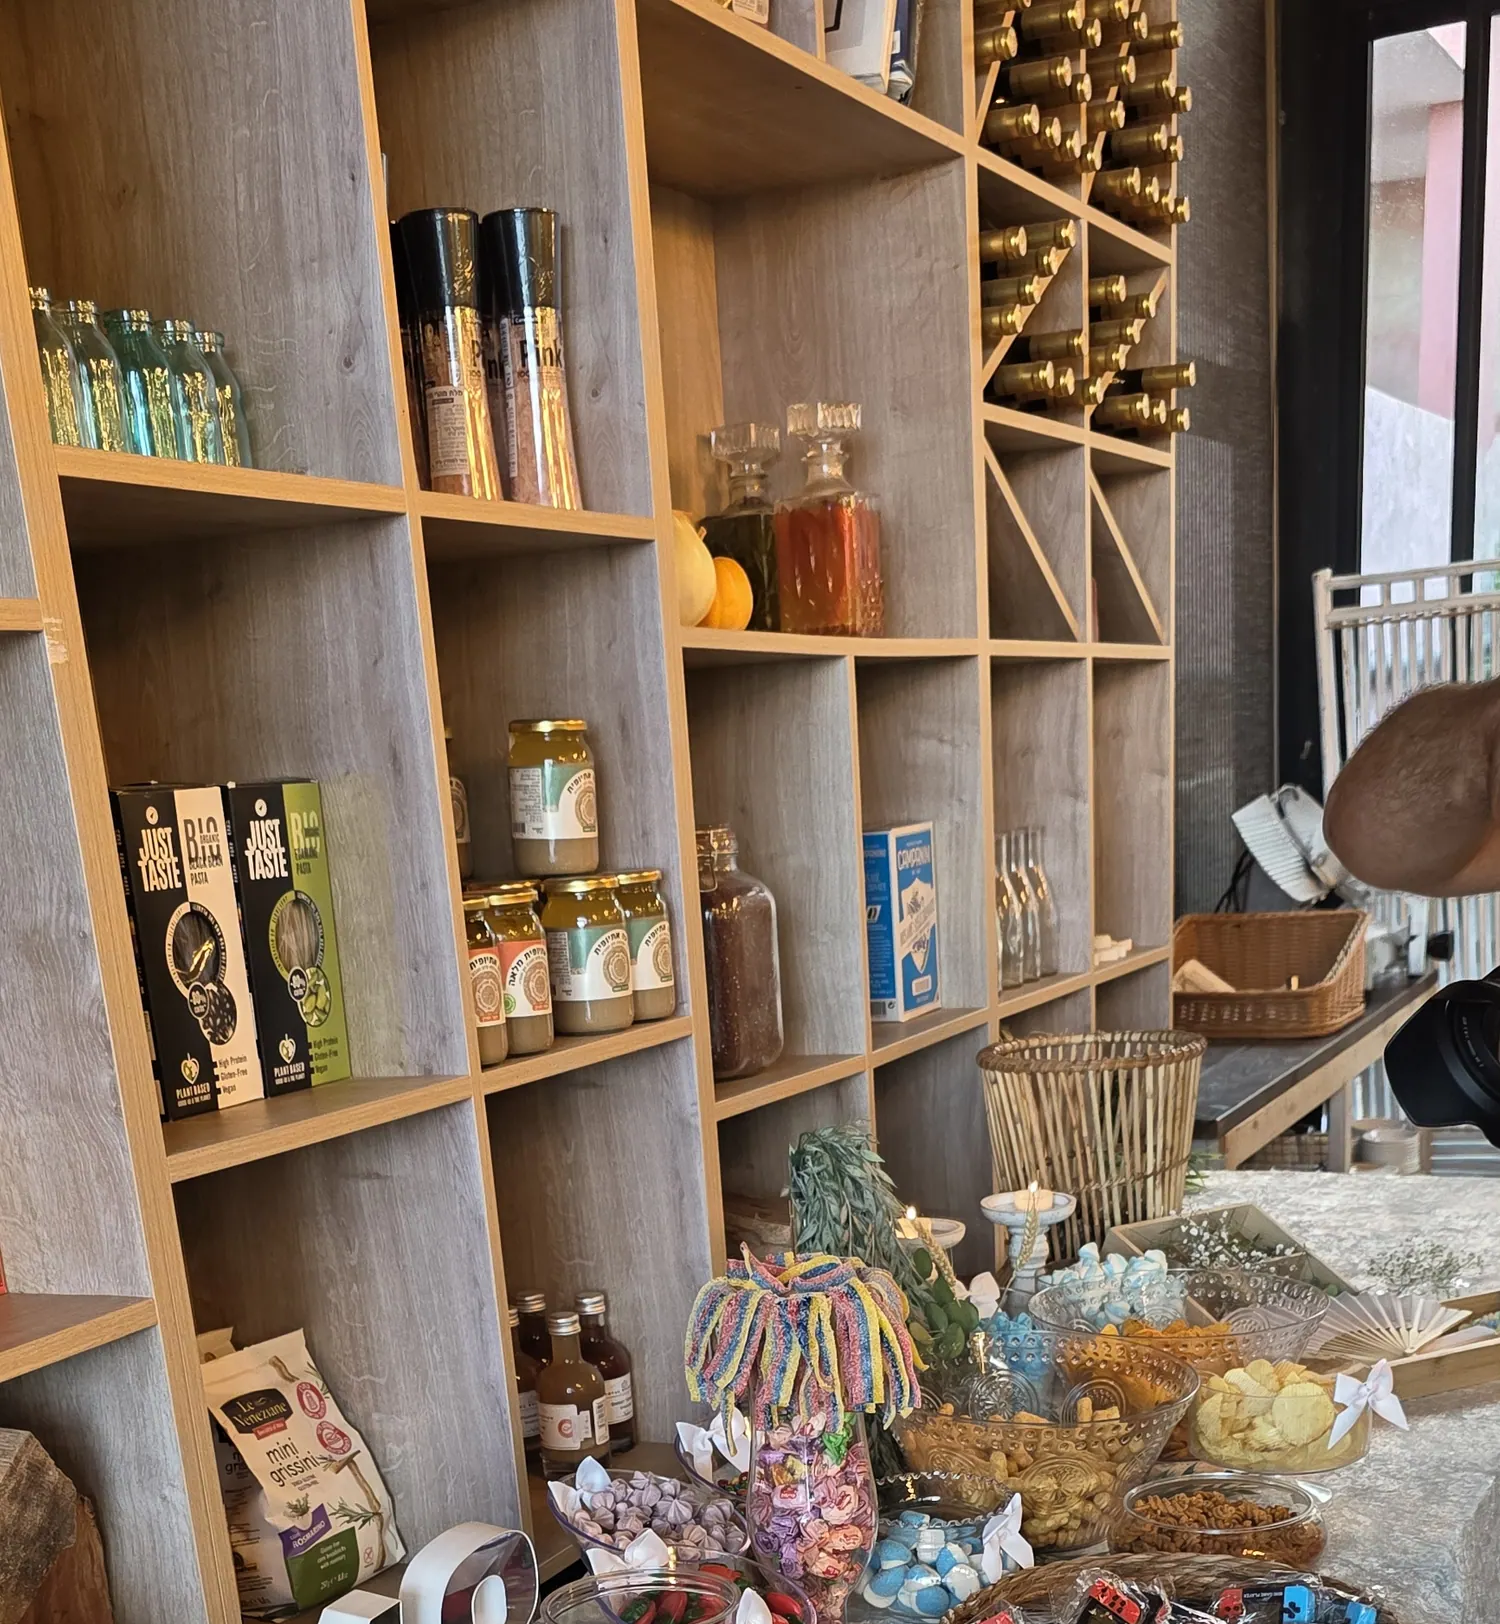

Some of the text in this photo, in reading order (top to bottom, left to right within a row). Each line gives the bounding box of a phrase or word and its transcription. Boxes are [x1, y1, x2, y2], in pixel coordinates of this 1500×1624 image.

[139, 827, 174, 861] JUST
[246, 819, 281, 852] JUST
[137, 857, 182, 892] TASTE
[190, 871, 209, 887] PASTA
[244, 847, 288, 880] TASTE
[508, 959, 523, 985] מלאה
[236, 1400, 255, 1413] Le
[266, 1437, 299, 1465] mini
[270, 1451, 320, 1488] grissini
